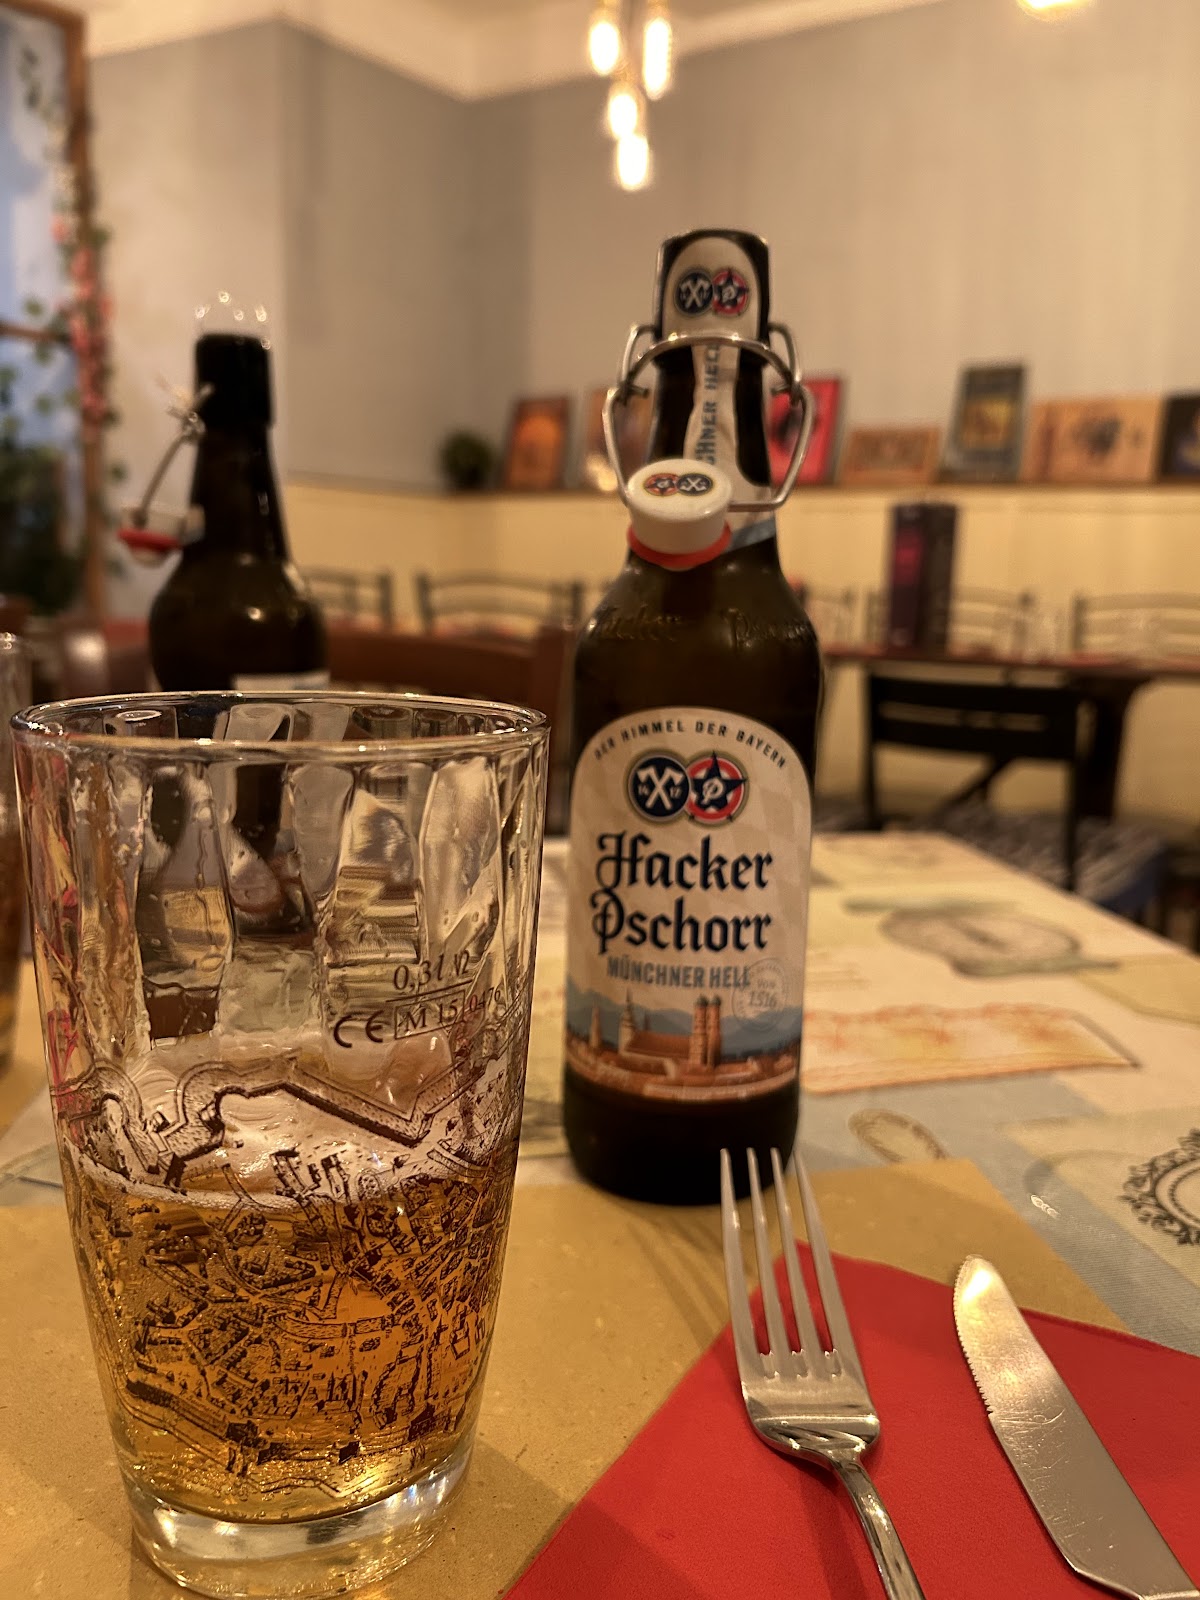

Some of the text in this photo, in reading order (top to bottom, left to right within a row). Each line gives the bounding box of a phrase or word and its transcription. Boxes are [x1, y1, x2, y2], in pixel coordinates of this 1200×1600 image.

[620, 719, 684, 742] HIMMEL
[695, 721, 727, 736] DER
[736, 730, 786, 768] BAYERN
[595, 830, 773, 889] Hacker
[589, 886, 772, 955] Pschorr
[607, 954, 704, 988] MÜNCHNER
